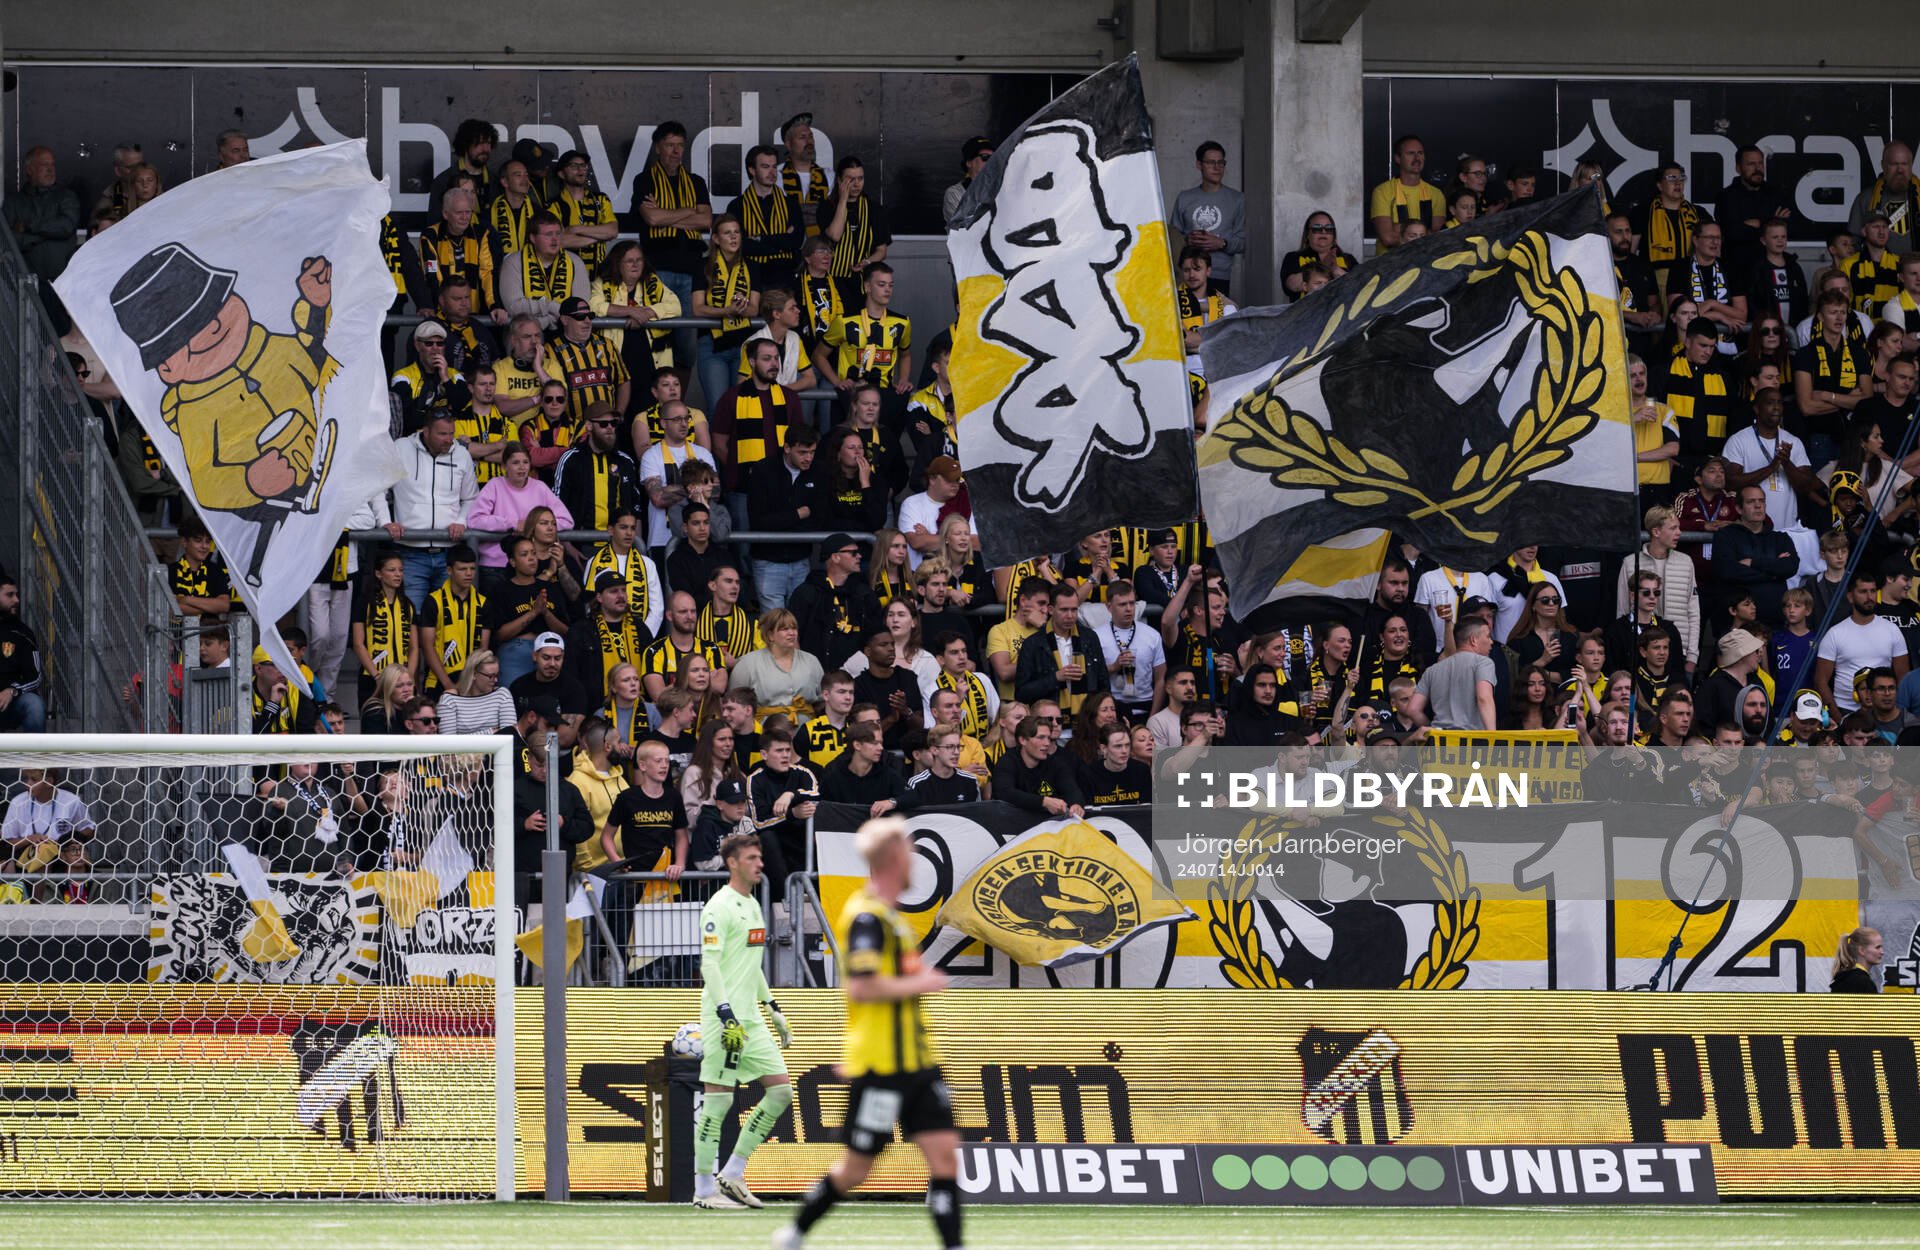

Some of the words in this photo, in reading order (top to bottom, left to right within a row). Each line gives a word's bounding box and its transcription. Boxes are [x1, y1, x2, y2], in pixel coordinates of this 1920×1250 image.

[1571, 563, 1594, 575] BOSS
[1777, 653, 1791, 670] 22
[1513, 812, 1806, 990] 12
[652, 1091, 664, 1187] SELECT
[957, 1149, 1186, 1194] UNIBET
[1466, 1148, 1701, 1195] UNIBET
